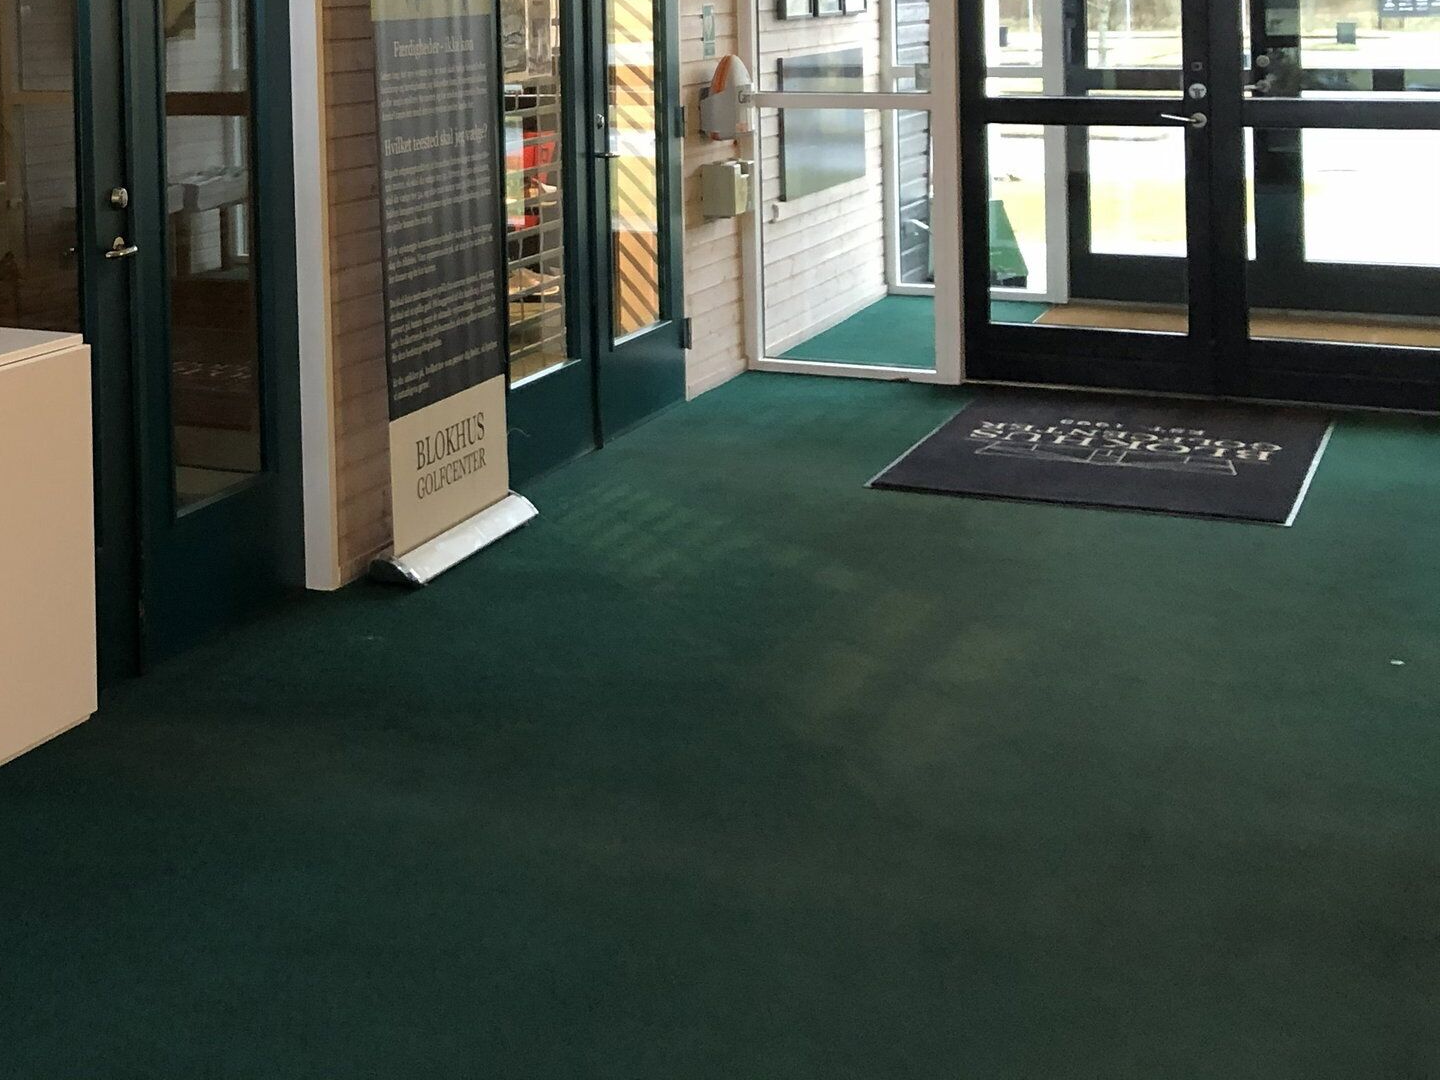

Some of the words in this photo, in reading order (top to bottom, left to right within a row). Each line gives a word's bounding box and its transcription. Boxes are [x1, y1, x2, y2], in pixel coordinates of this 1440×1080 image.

[385, 134, 412, 157] Hvilket
[412, 129, 440, 152] teested
[415, 411, 485, 470] BLOKHUS
[969, 428, 1271, 461] BLOKHUS
[981, 421, 1283, 452] GOLFCENTER
[416, 447, 487, 500] GOLFCENTER
